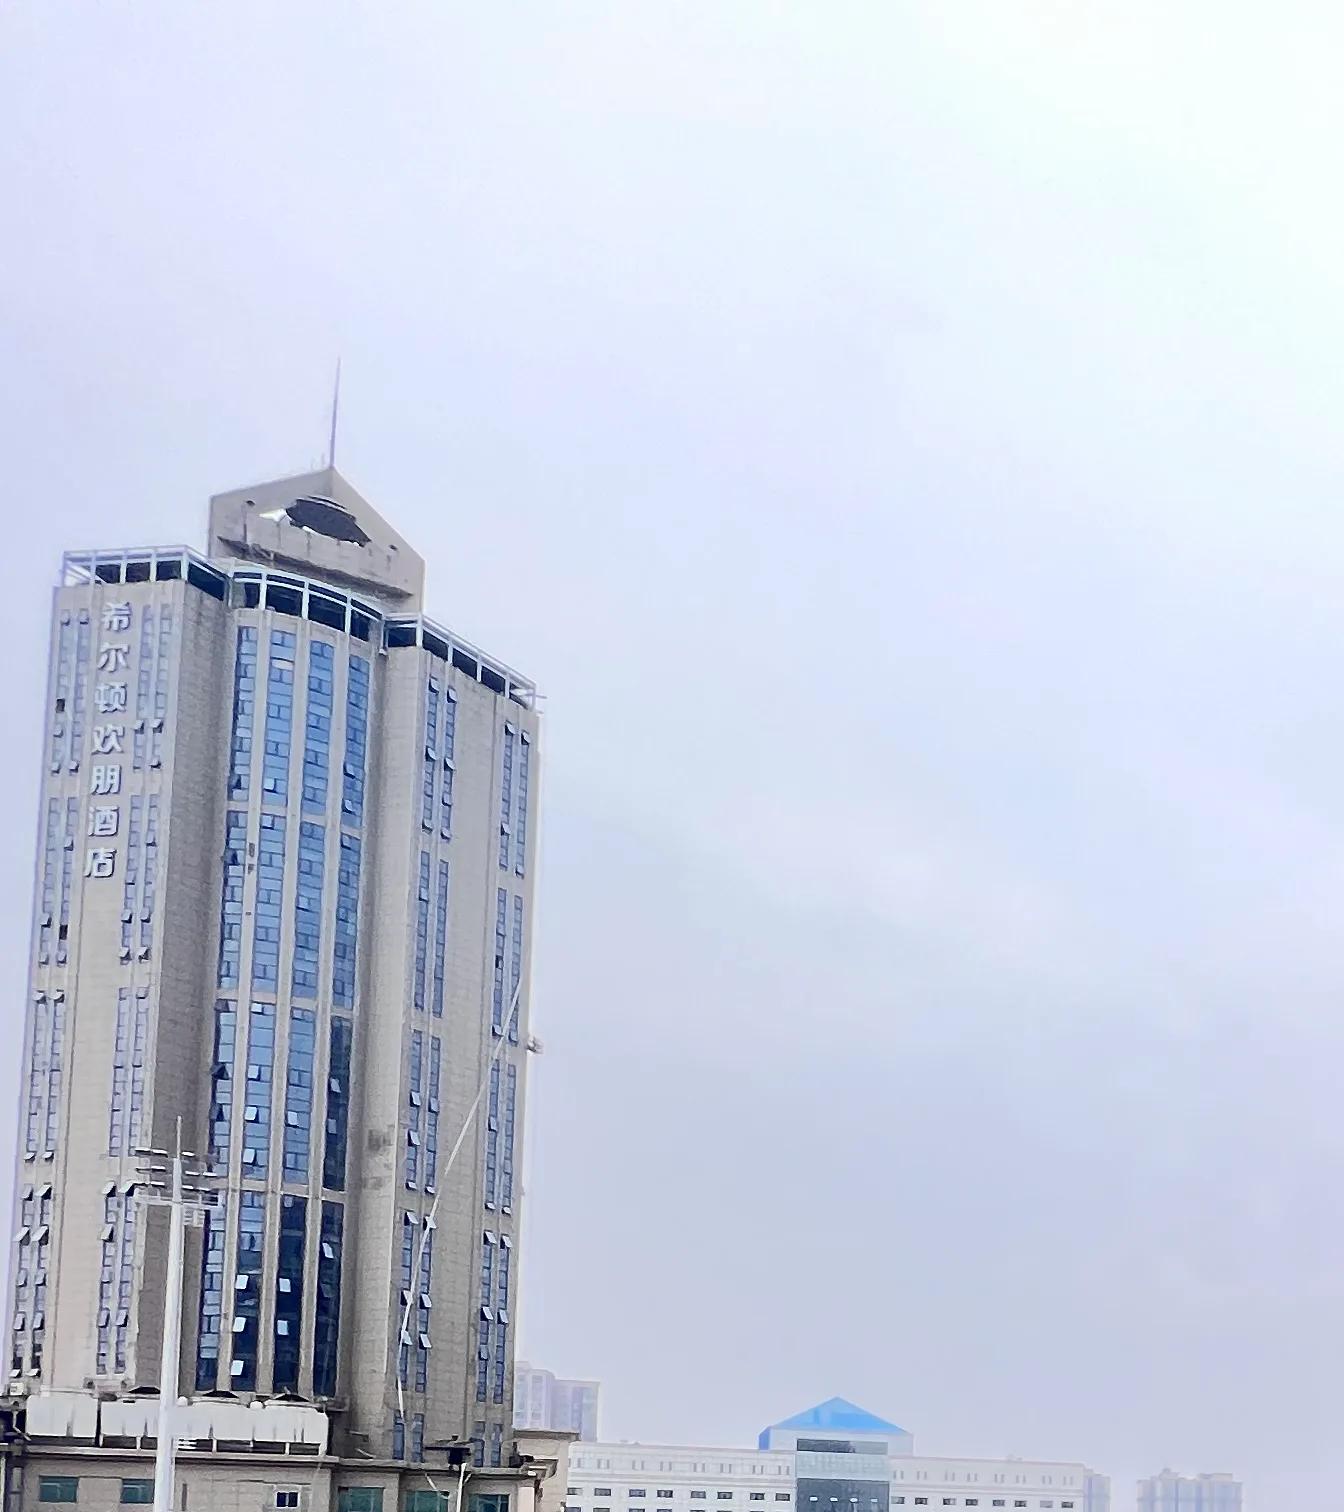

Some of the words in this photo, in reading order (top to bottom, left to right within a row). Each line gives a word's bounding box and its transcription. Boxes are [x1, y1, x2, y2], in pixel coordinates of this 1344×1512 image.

[85, 602, 132, 879] 希尔顿欢朋酒店
